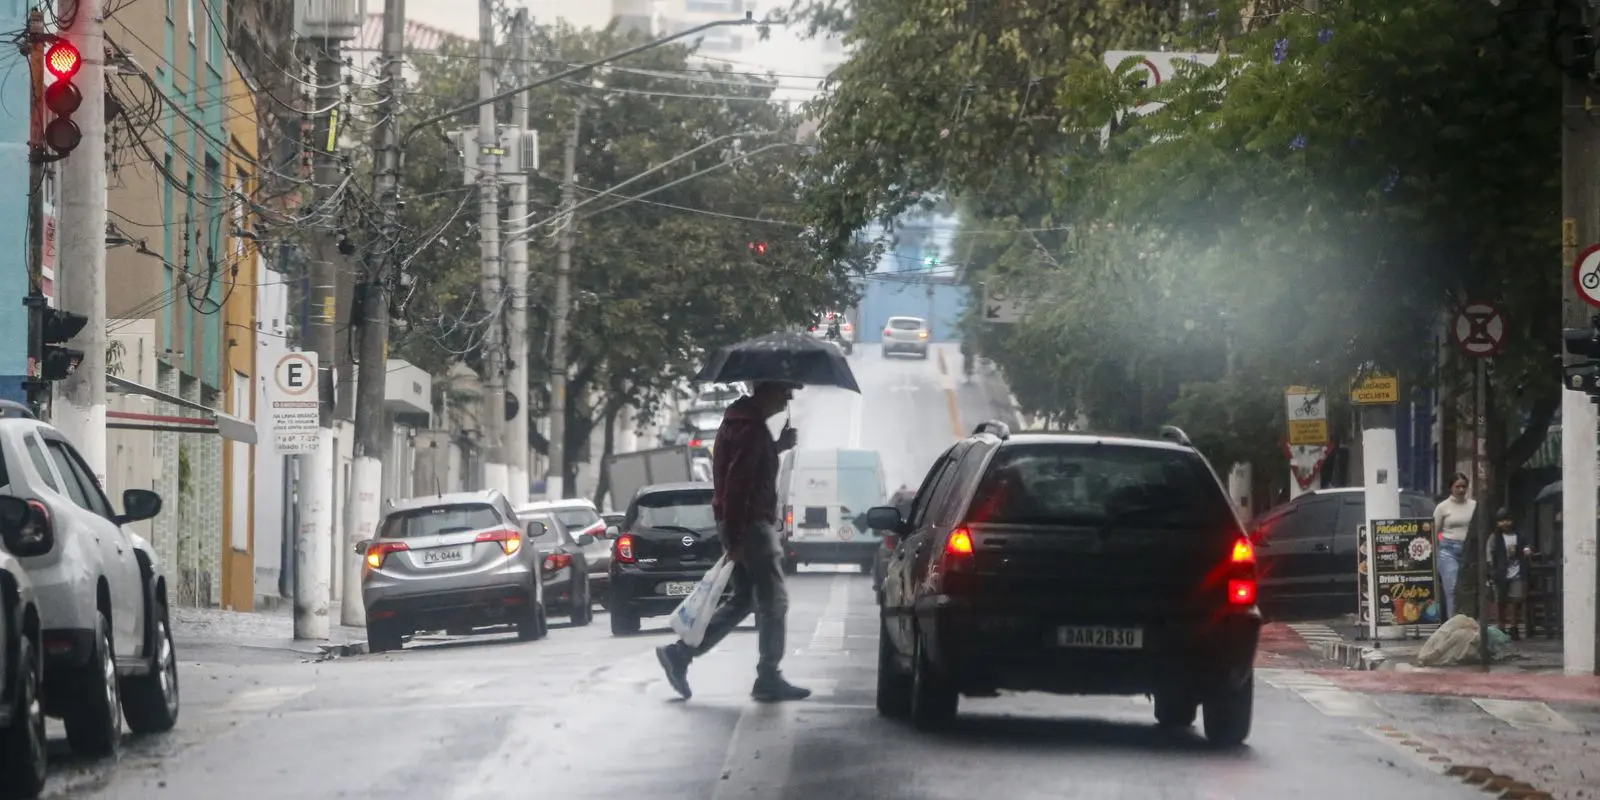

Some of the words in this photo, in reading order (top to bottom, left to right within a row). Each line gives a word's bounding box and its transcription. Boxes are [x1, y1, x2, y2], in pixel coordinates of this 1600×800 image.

[288, 363, 302, 387] E
[1358, 392, 1390, 400] CICLISTA
[1376, 524, 1418, 533] PROMOÇÃO
